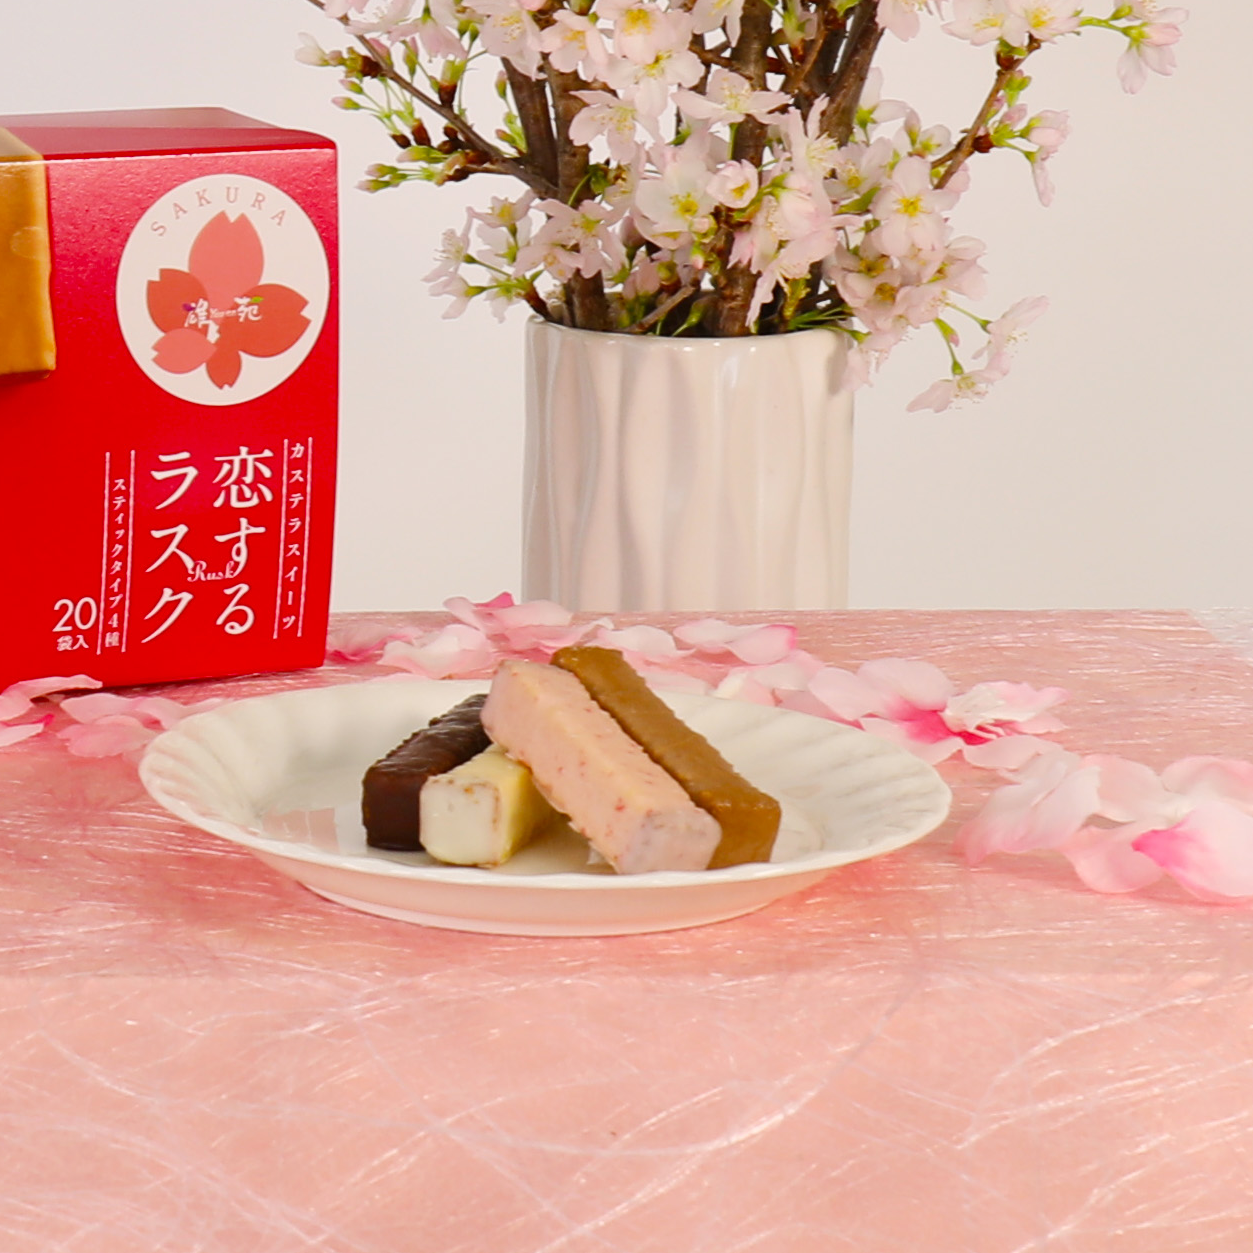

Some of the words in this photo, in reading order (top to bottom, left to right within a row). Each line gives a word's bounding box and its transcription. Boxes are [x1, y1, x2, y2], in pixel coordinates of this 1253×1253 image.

[151, 186, 287, 237] SAKURA
[141, 451, 199, 644] ラスク
[186, 560, 235, 582] Rusk
[212, 445, 274, 636] 恋する
[282, 442, 305, 630] カステラスイーツ
[52, 596, 98, 632] 20
